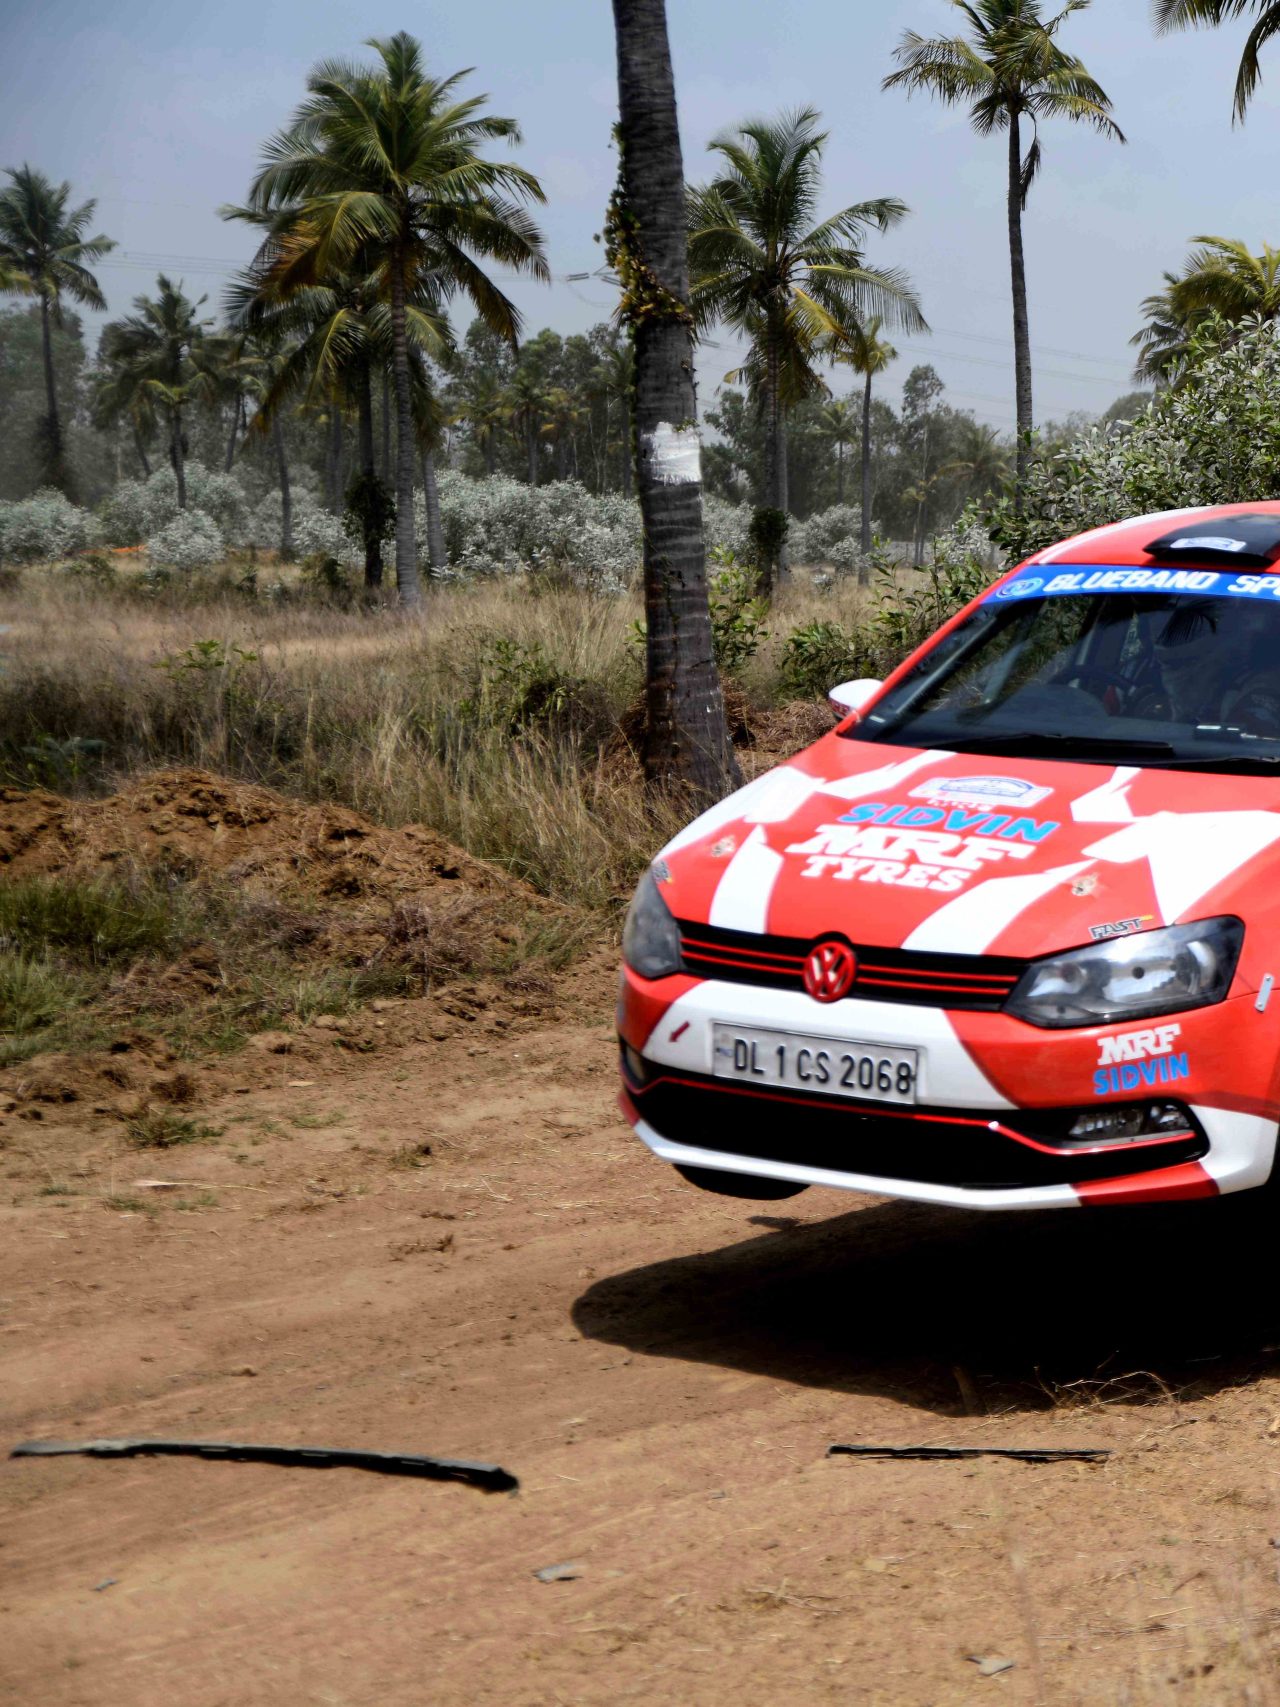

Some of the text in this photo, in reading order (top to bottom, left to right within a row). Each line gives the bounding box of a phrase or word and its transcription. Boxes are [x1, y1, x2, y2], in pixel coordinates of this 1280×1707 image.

[1042, 570, 1220, 592] BLUEBAND
[837, 802, 1061, 843] SIDVIN
[784, 824, 1037, 871] MRF
[800, 856, 973, 892] TYRES
[1088, 917, 1141, 940] FAST
[1097, 1023, 1181, 1066] MRF
[840, 1054, 913, 1094] 2068
[1093, 1052, 1189, 1095] SIDVIN
